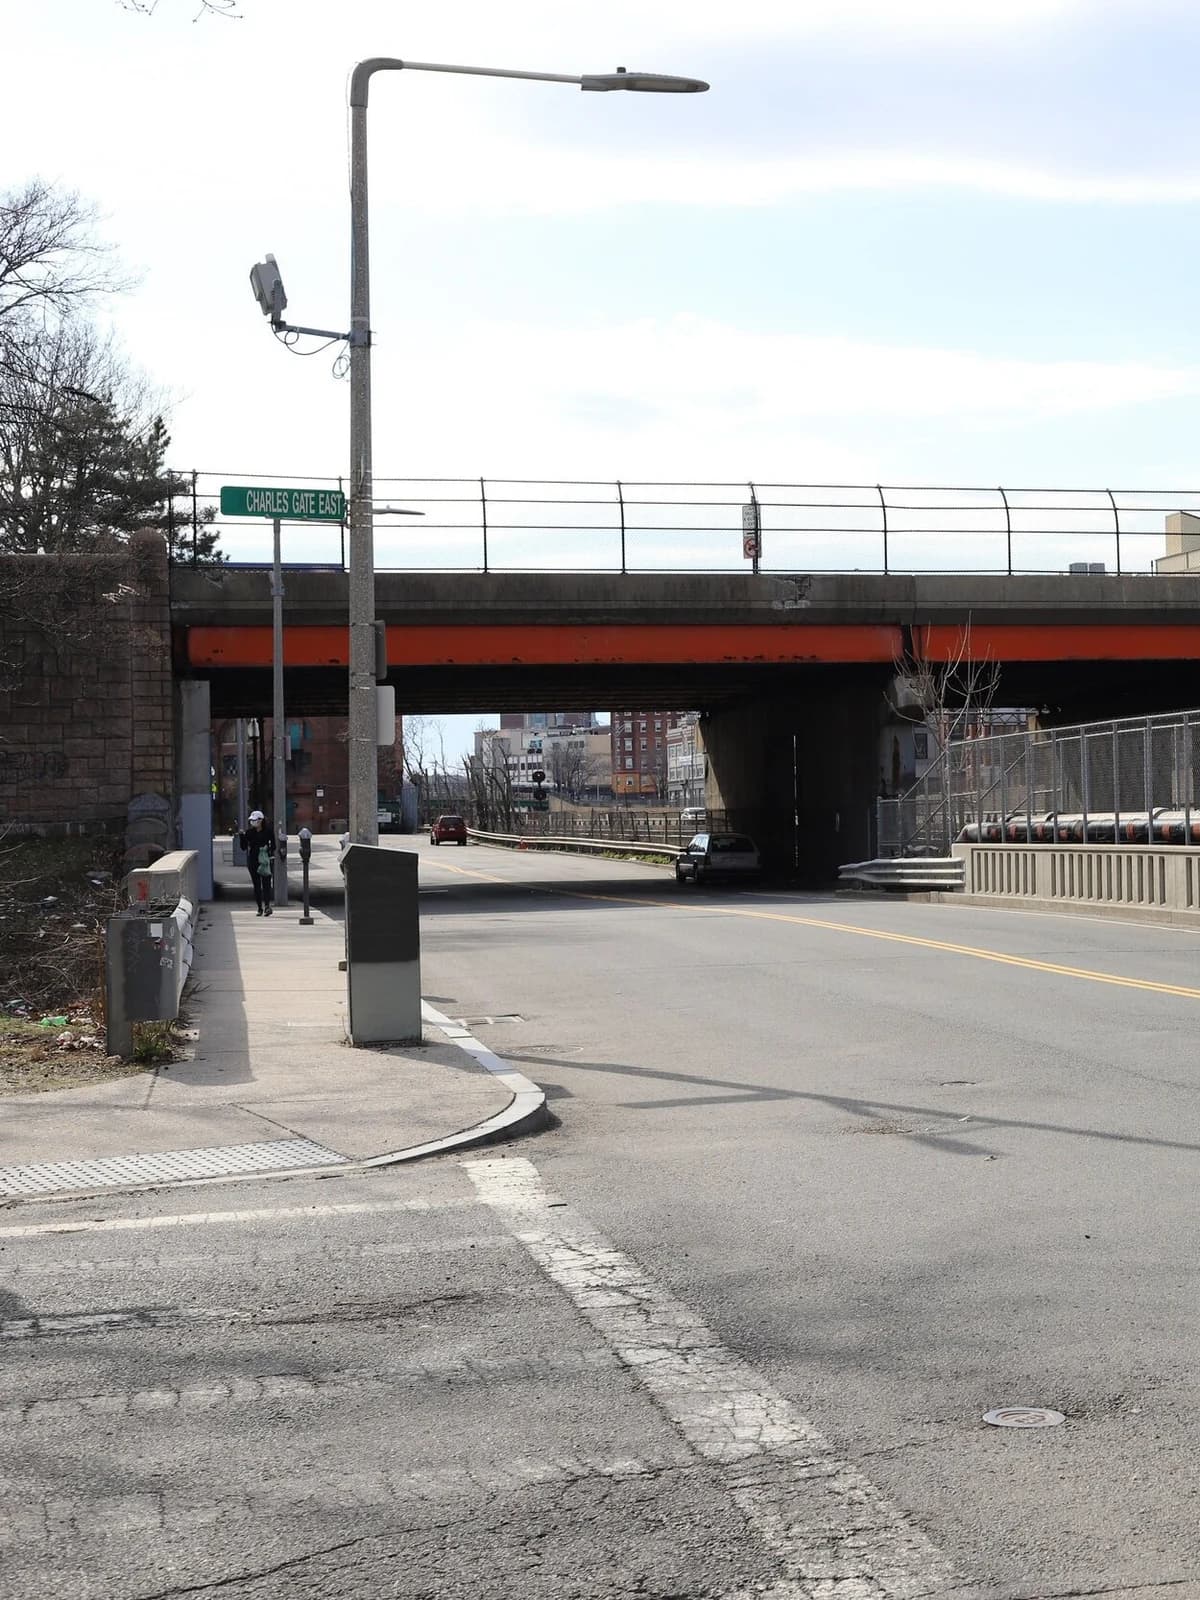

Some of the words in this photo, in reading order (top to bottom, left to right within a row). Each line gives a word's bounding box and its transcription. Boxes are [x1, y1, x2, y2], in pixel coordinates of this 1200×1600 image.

[246, 490, 289, 513] CHARLES
[292, 492, 315, 514] GATE
[318, 493, 343, 515] EAST
